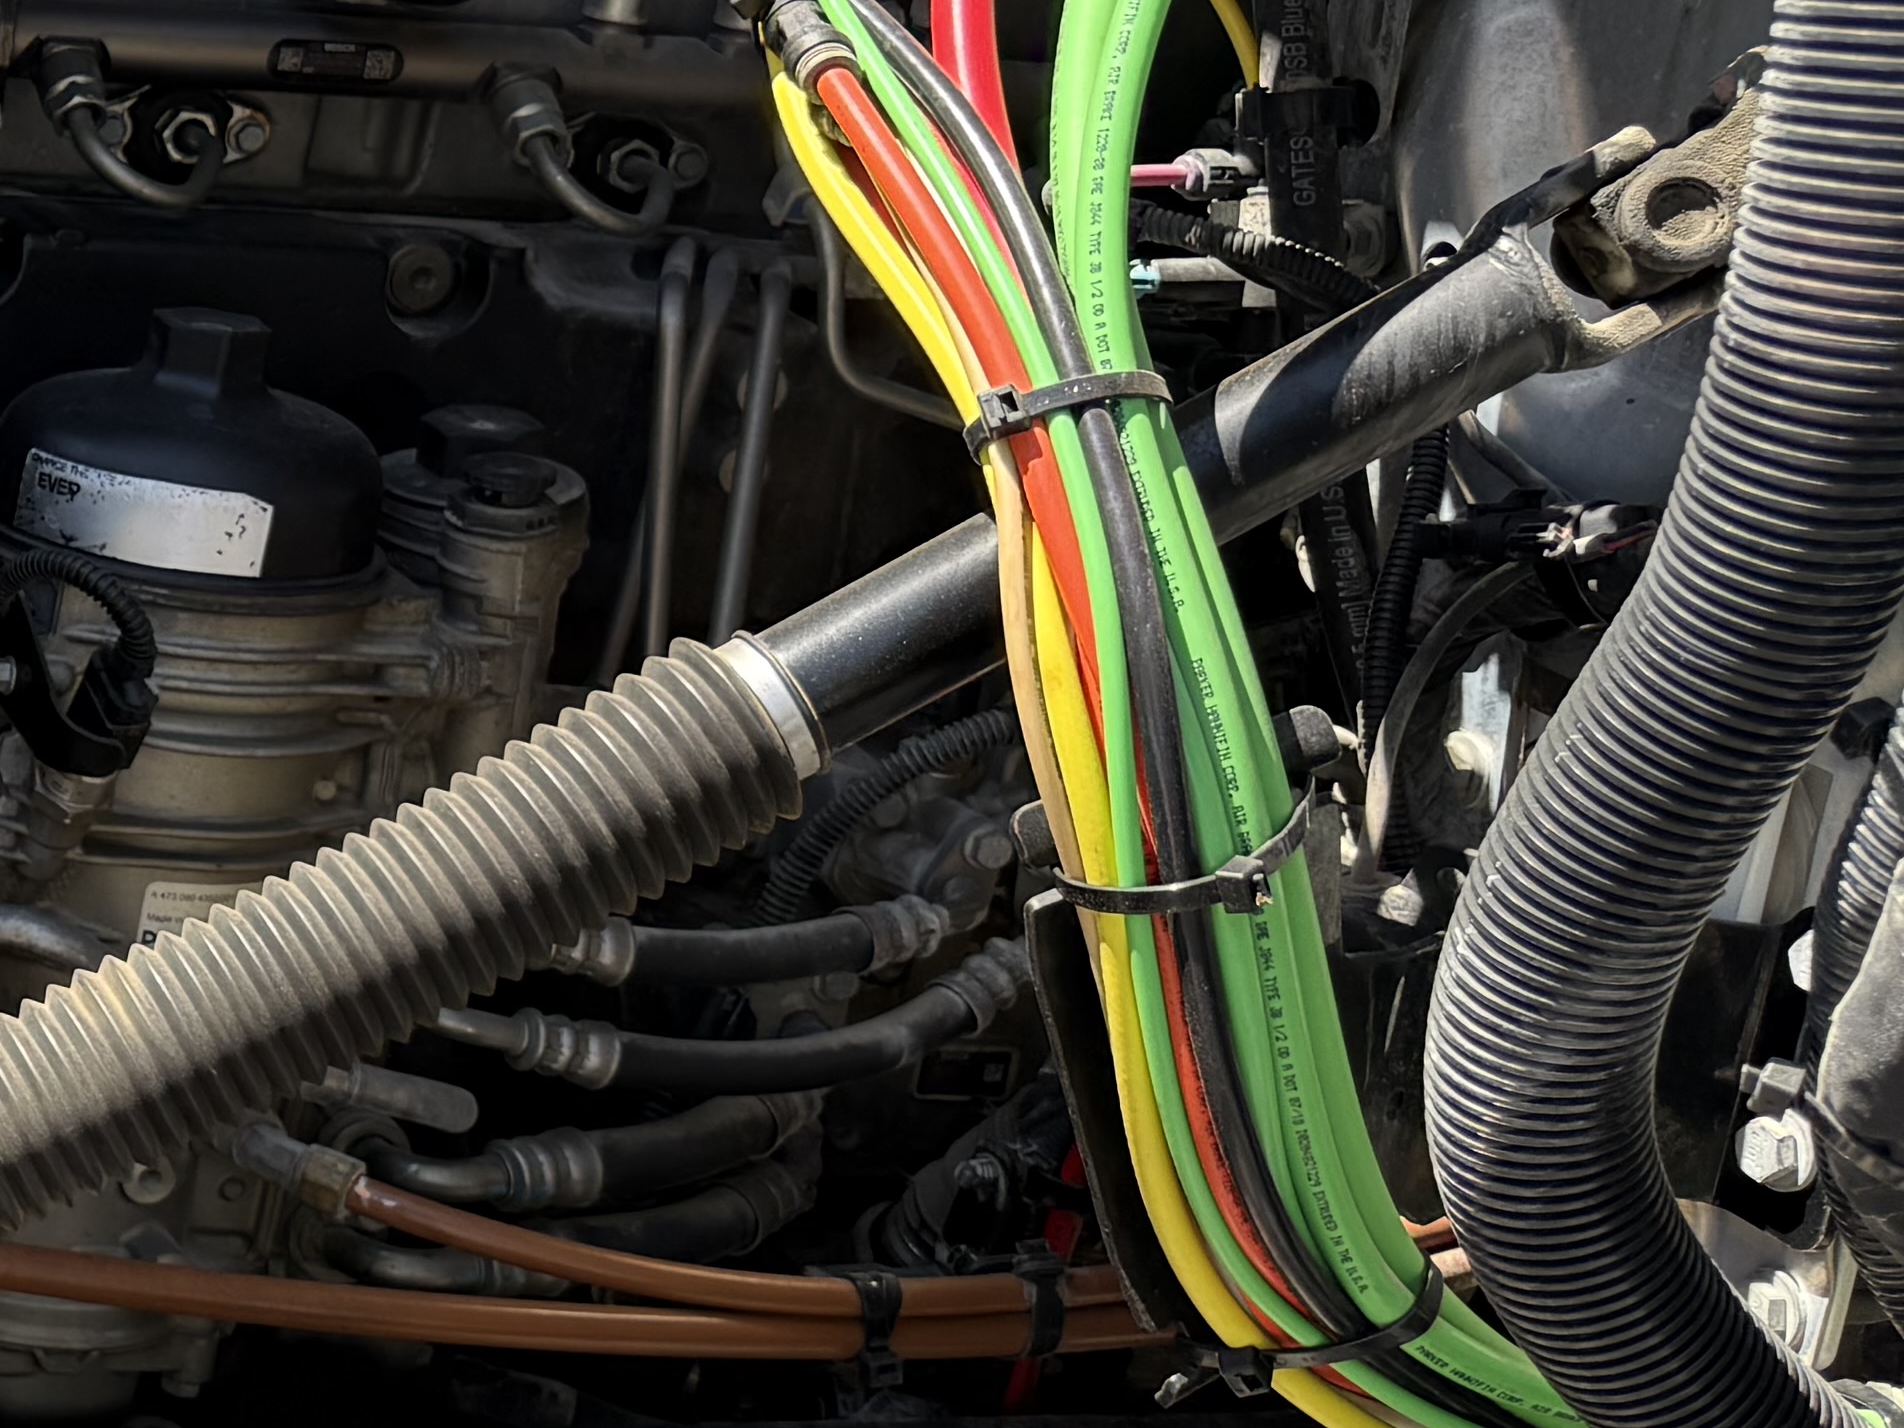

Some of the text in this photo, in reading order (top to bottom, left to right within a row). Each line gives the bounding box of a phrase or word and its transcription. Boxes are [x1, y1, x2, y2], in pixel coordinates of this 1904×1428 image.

[1292, 134, 1317, 209] GATES
[1326, 523, 1362, 598] Made in
[1262, 975, 1281, 1001] TYPE
[1271, 1023, 1289, 1043] 1/2
[1281, 1074, 1299, 1093] DOT
